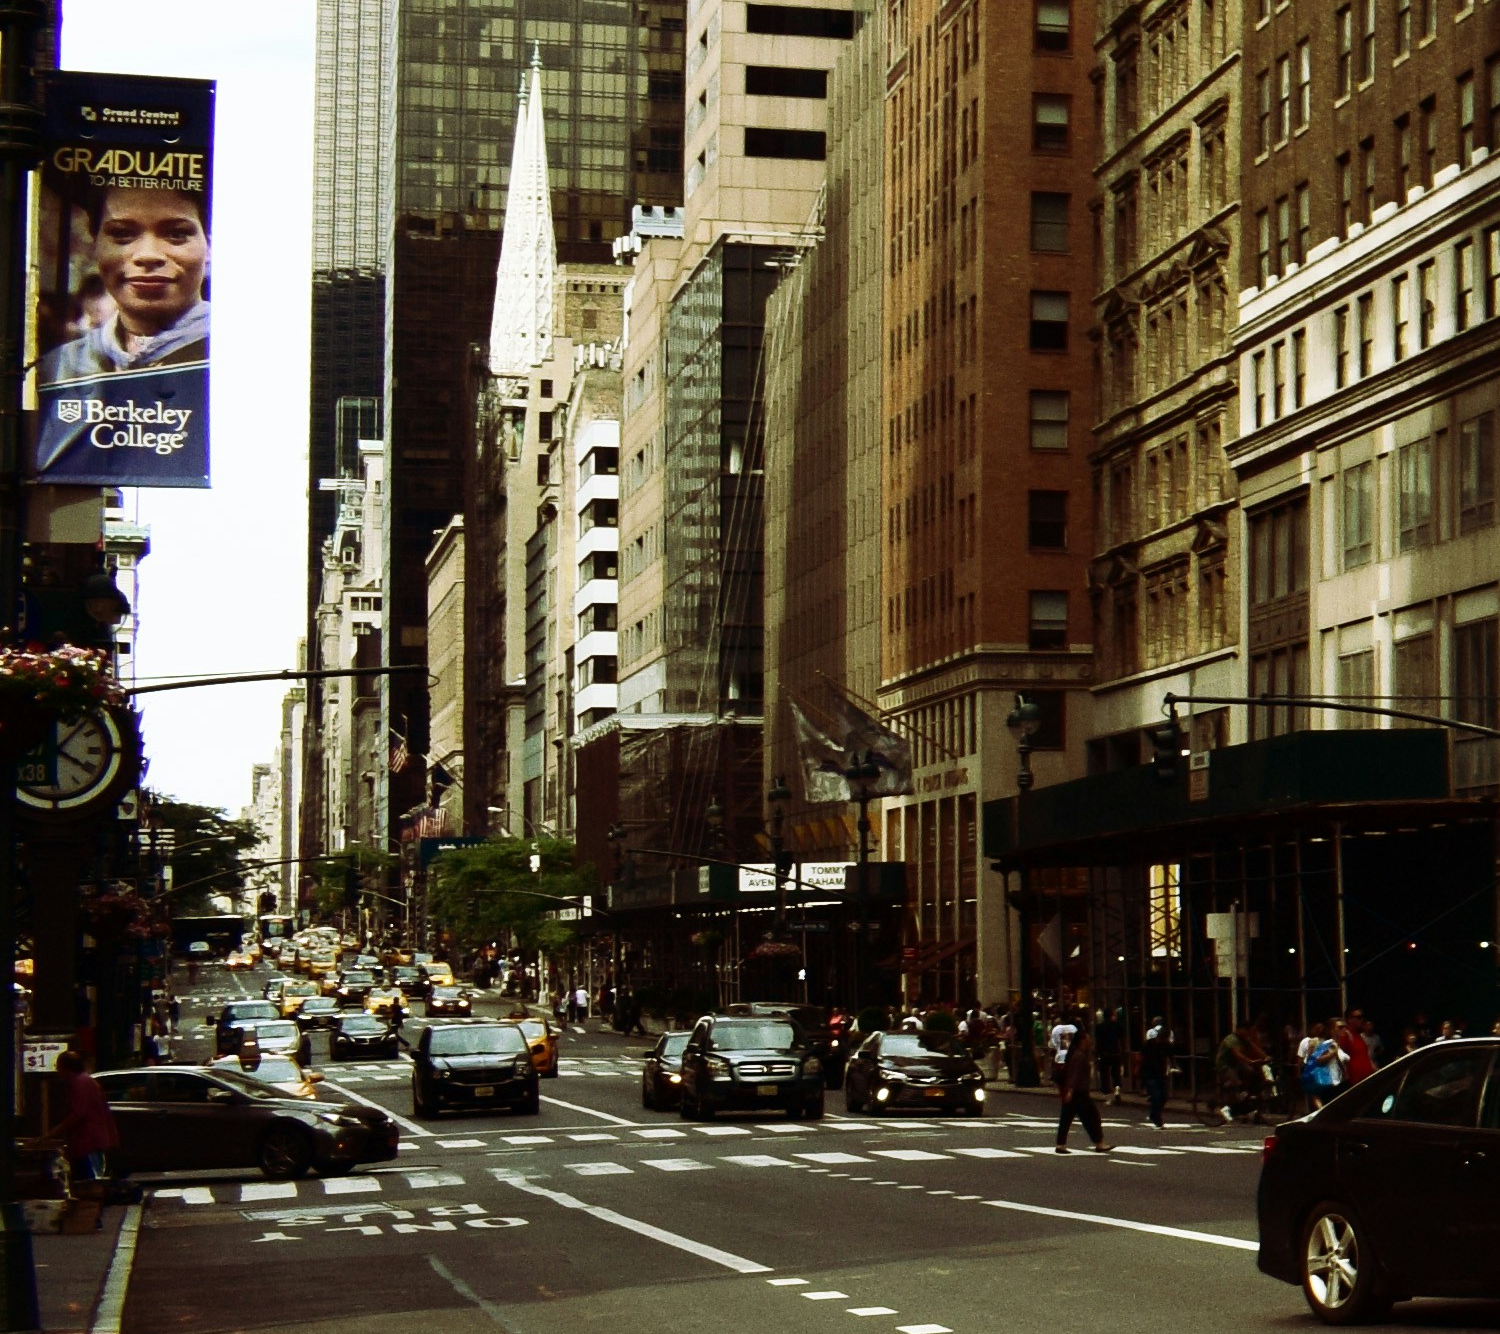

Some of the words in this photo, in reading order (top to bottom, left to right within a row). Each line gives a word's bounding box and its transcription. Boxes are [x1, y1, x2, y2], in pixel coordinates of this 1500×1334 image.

[54, 147, 204, 178] GRADUATE
[90, 175, 104, 186] TO
[107, 176, 116, 186] A
[118, 177, 159, 189] BETTER
[161, 179, 203, 191] FUTURE
[85, 399, 192, 431] Berkeley
[90, 424, 184, 455] College
[808, 877, 845, 886] BAHAM
[250, 1217, 529, 1242] ONLY
